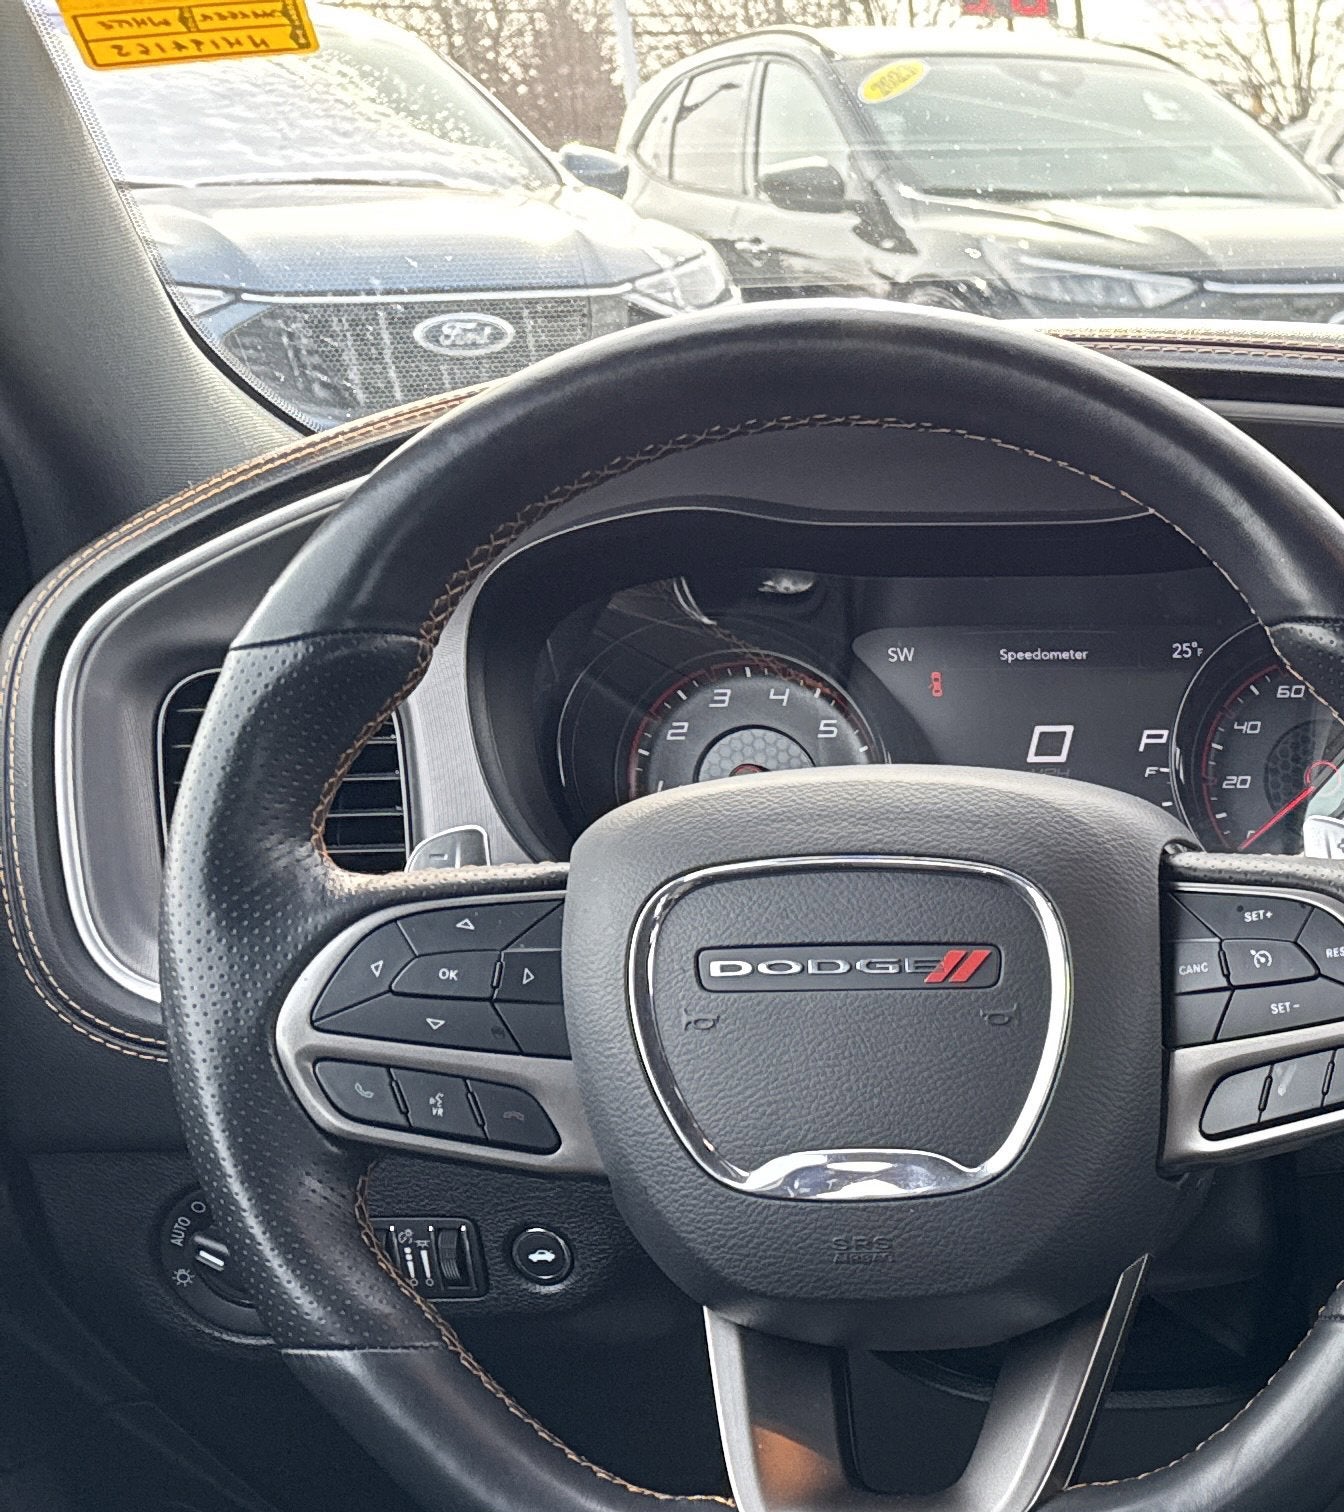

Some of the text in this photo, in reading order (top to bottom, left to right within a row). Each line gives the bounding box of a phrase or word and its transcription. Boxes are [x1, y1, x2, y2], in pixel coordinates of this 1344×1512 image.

[438, 321, 492, 346] Ford
[887, 646, 915, 663] SW
[999, 647, 1089, 664] Speedometer
[708, 688, 732, 708] 3
[768, 687, 790, 707] 4
[1276, 684, 1306, 699] 60
[666, 721, 689, 741] 2
[817, 719, 838, 738] 5
[1233, 720, 1262, 734] 40
[1138, 729, 1170, 752] P
[1222, 774, 1251, 789] 20
[438, 967, 459, 982] OK
[708, 956, 945, 978] DODGE
[1178, 961, 1209, 976] CANC
[169, 1216, 192, 1248] AUTO
